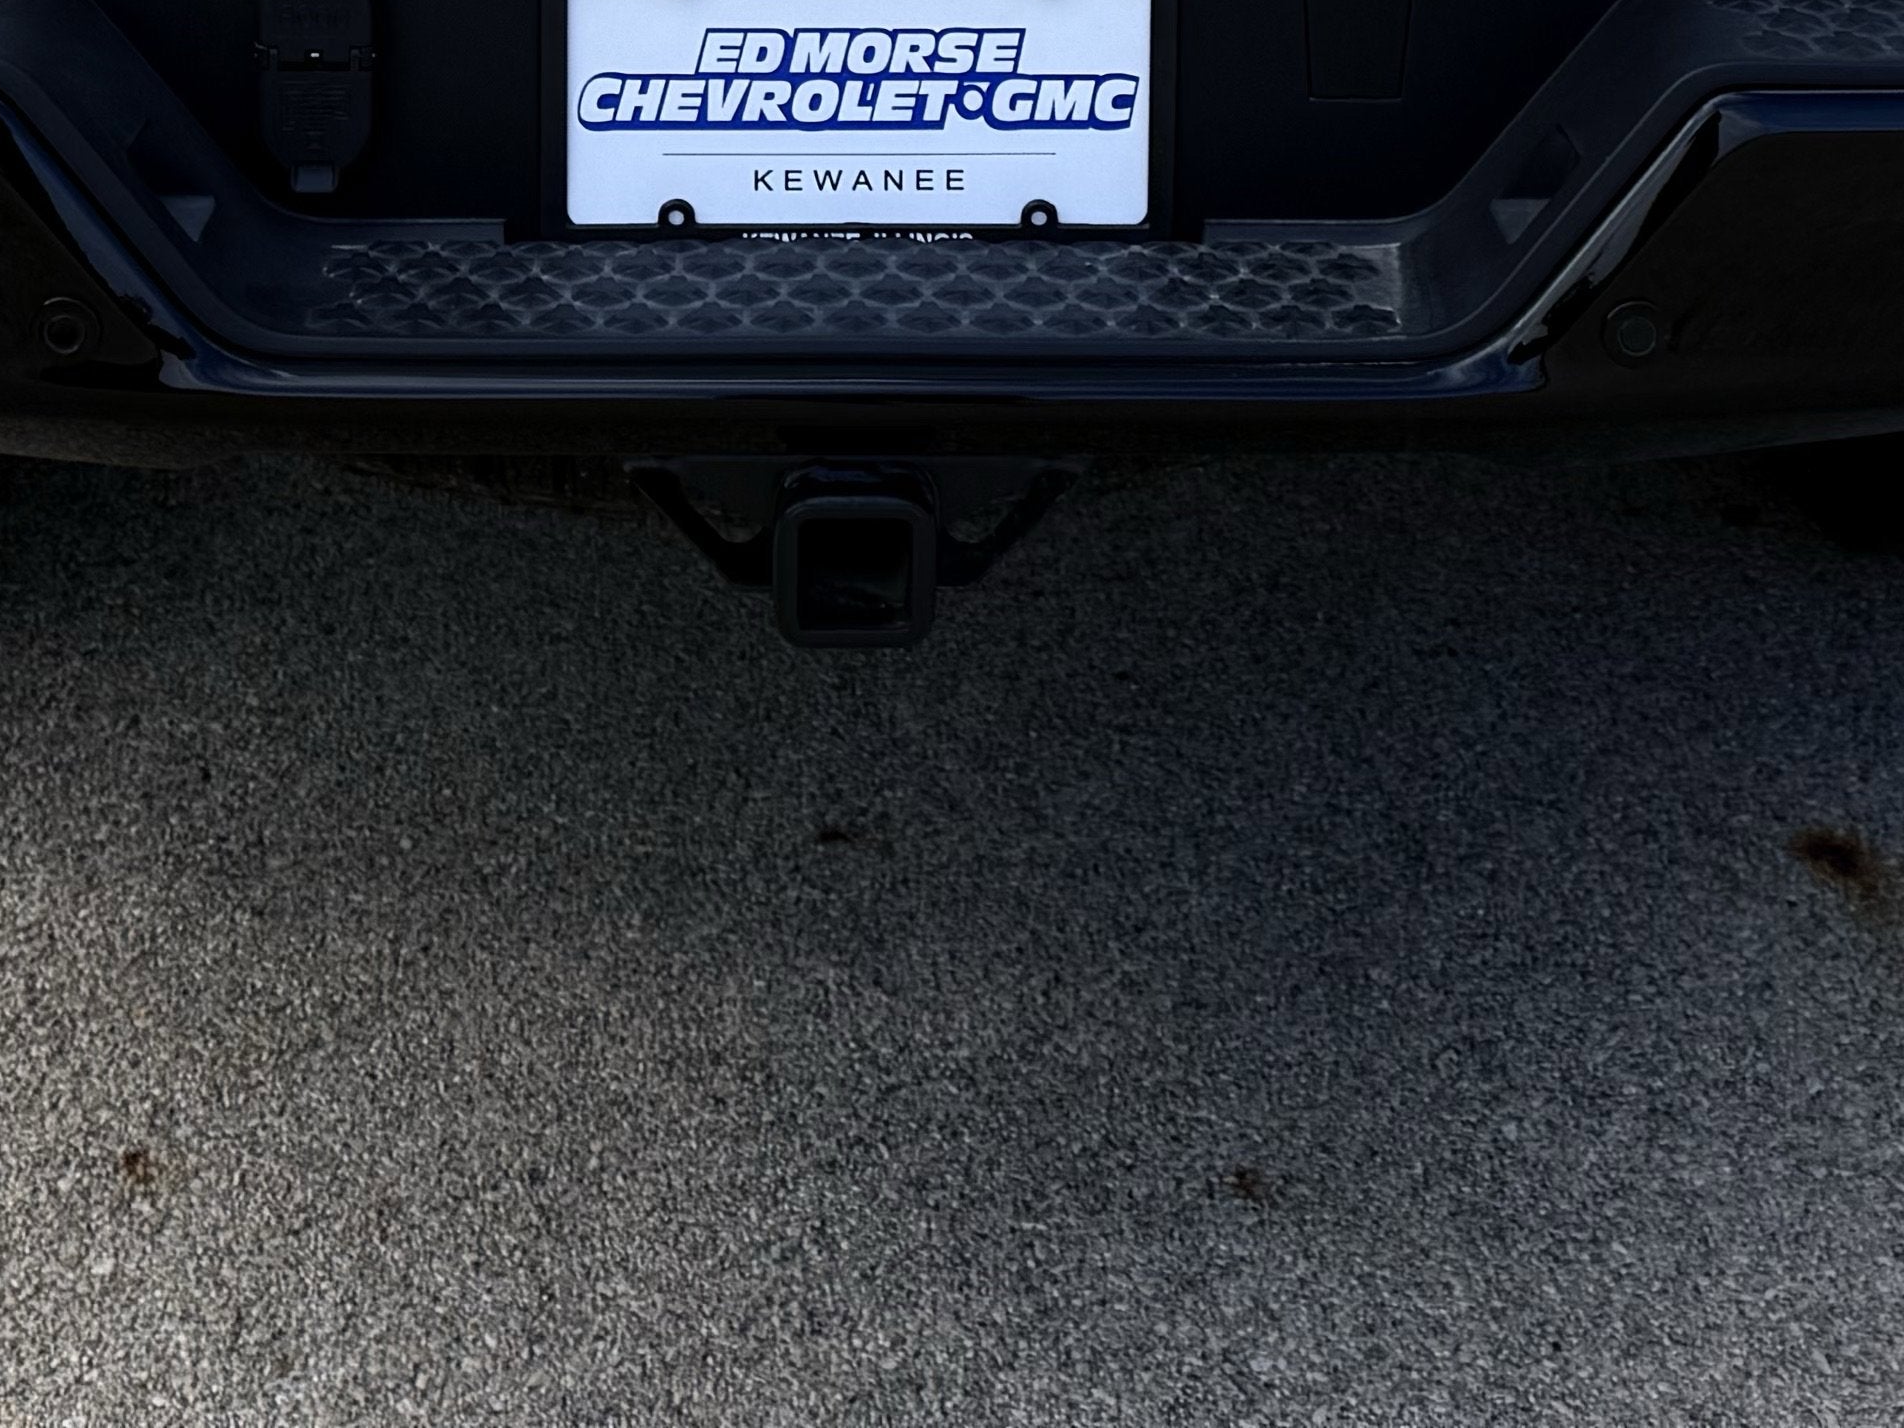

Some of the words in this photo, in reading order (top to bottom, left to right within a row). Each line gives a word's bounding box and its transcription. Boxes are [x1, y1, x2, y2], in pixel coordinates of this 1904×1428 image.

[697, 32, 794, 73] ED
[792, 30, 1023, 74] MORSE
[753, 169, 966, 192] KEWANEE
